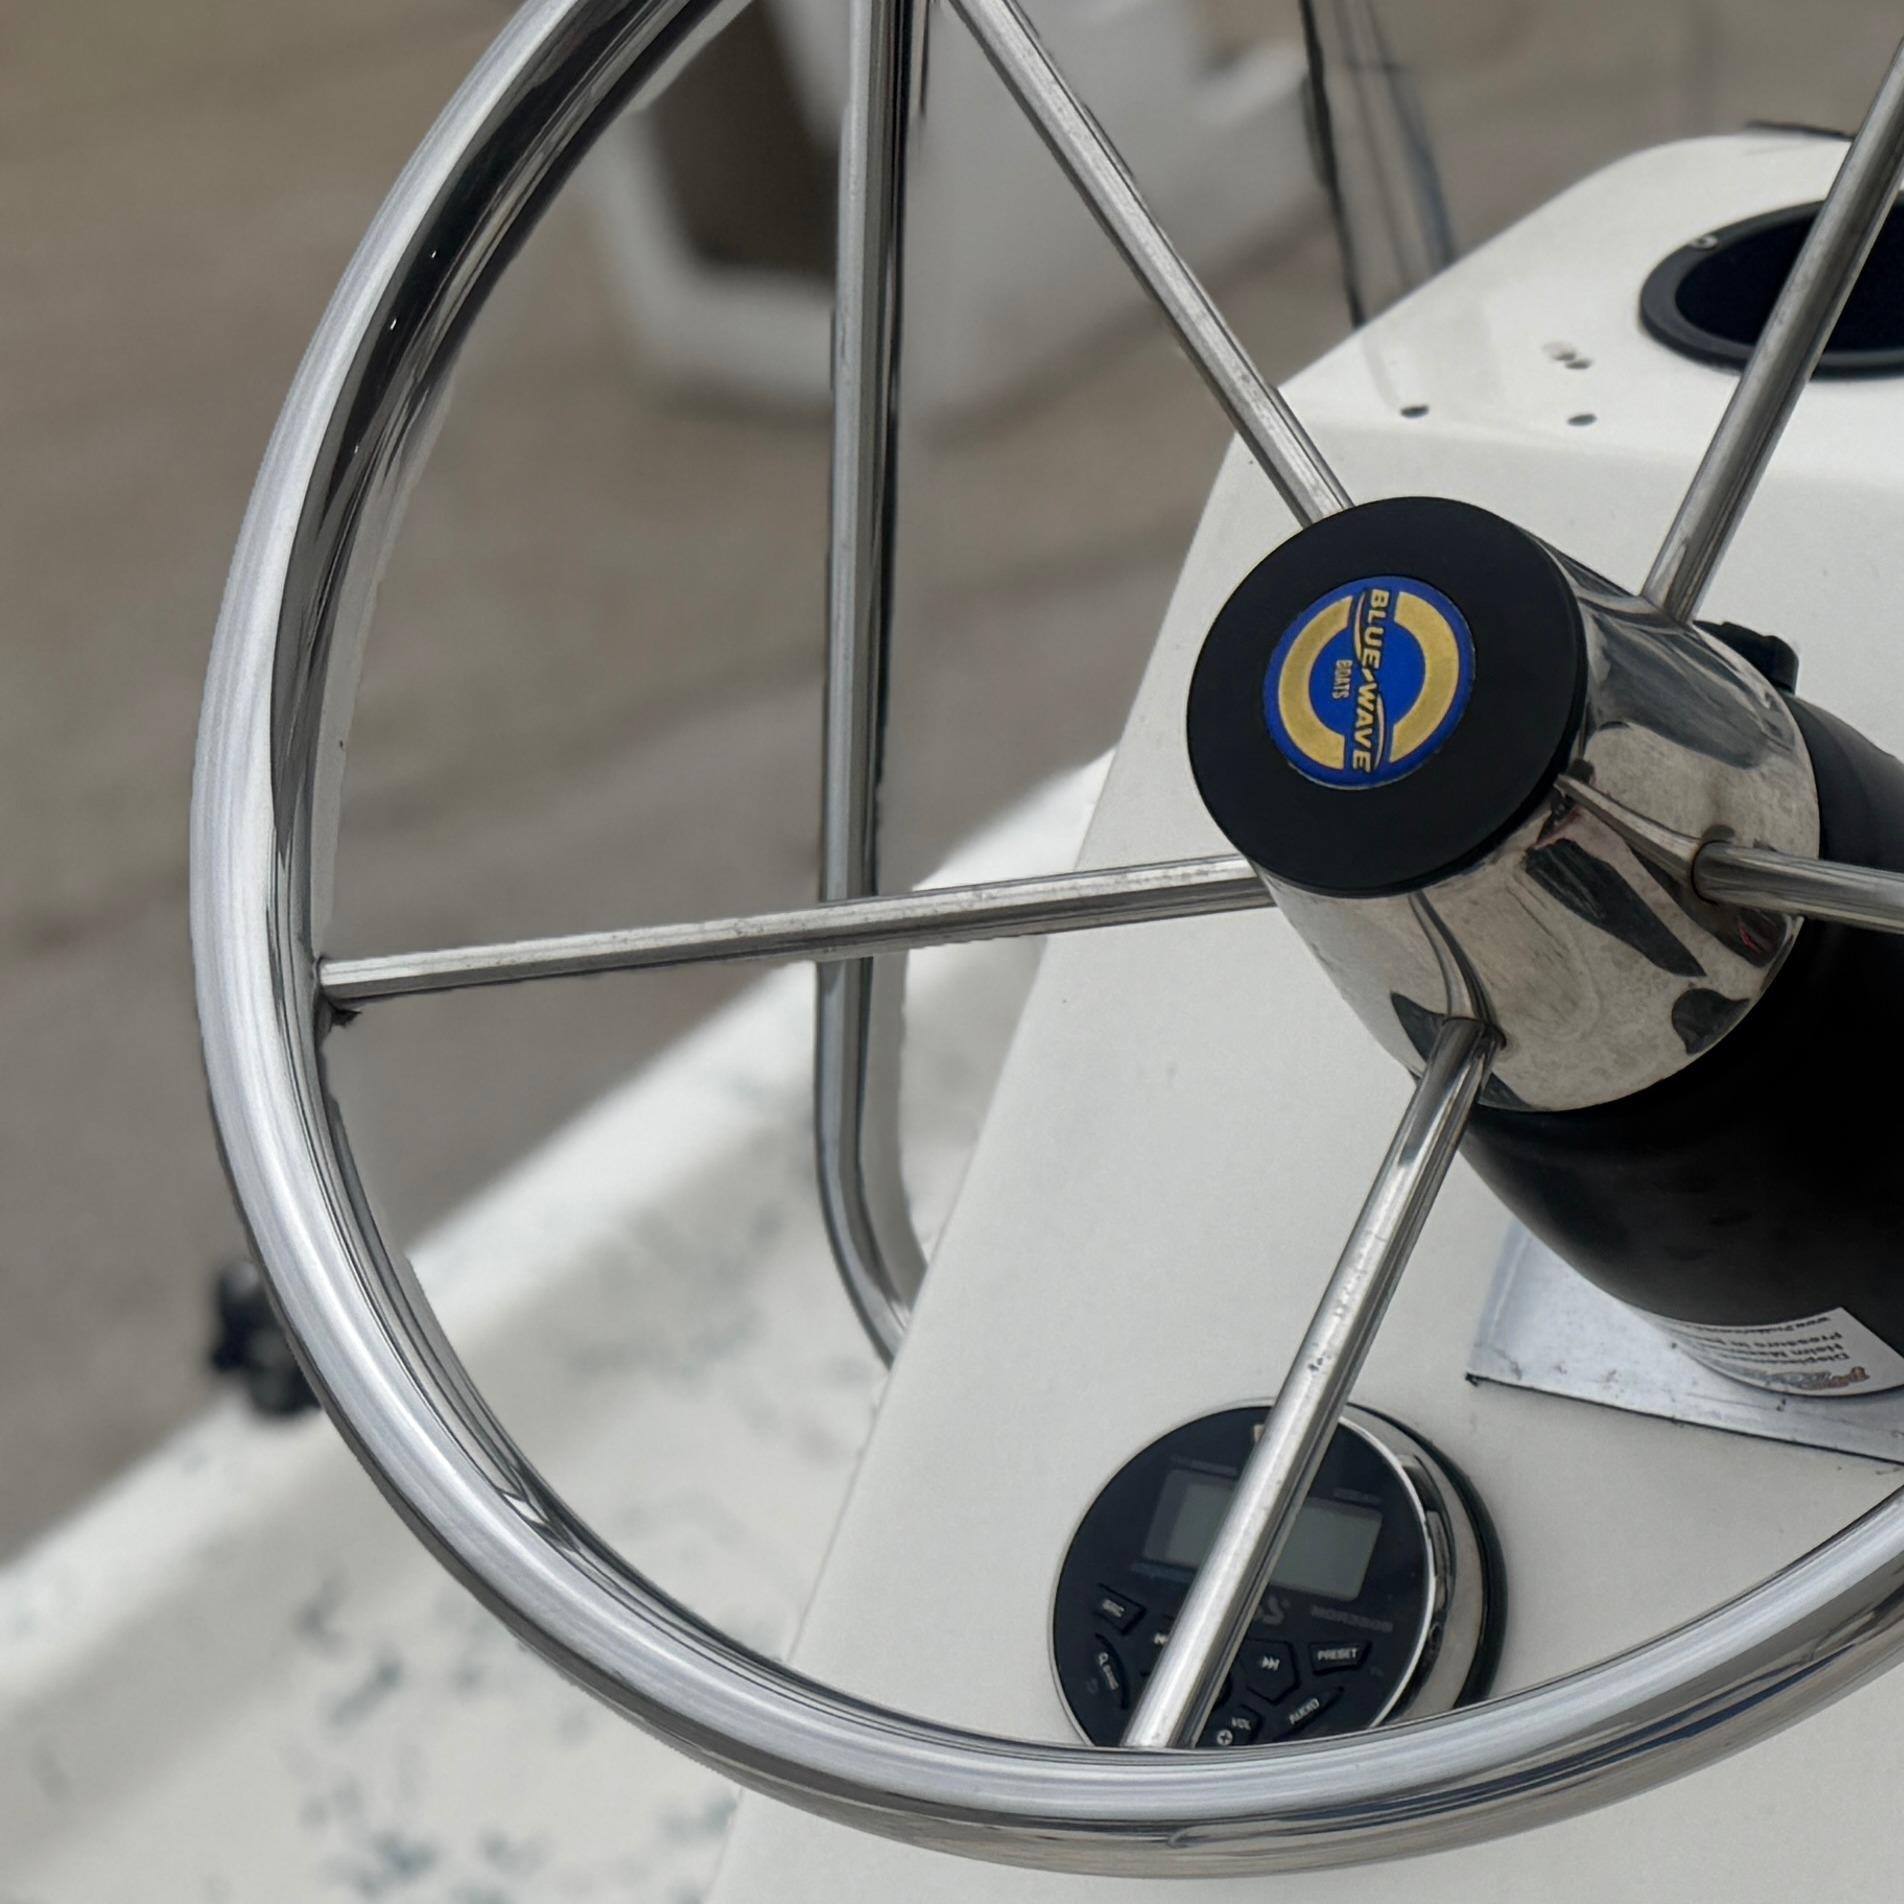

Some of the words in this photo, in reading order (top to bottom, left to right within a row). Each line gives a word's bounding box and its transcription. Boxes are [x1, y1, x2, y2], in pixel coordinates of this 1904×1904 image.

[1362, 588, 1390, 670] BLUE
[1332, 659, 1353, 700] BOATS
[1352, 682, 1377, 774] WAVE
[1317, 1646, 1359, 1661] PRESET
